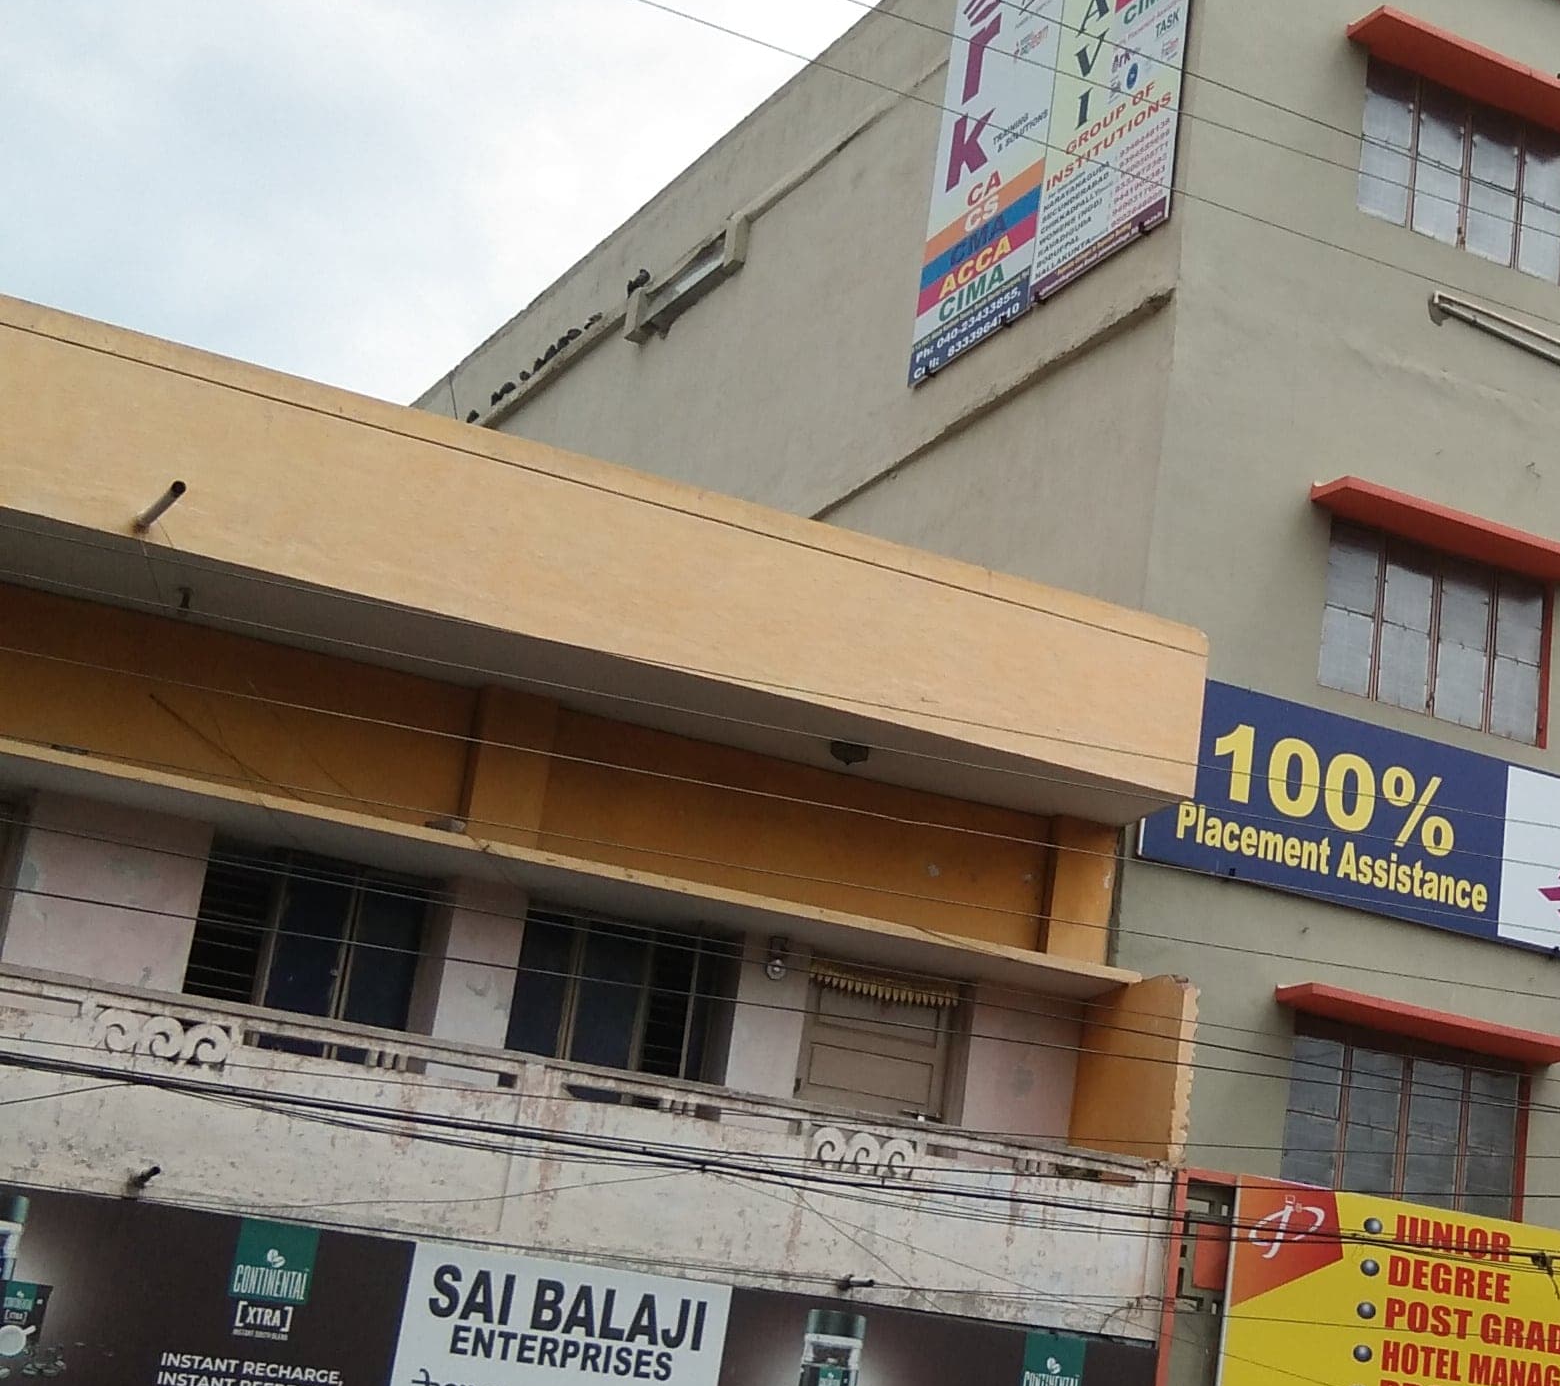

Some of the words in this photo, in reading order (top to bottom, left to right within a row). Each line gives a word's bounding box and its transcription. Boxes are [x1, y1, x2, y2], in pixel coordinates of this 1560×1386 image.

[1155, 8, 1180, 37] TASK
[1046, 92, 1172, 192] INSTITUTIONS
[1066, 103, 1126, 155] GROUP
[1132, 81, 1156, 107] OF
[967, 170, 1002, 206] CA
[964, 197, 999, 232] CS
[950, 218, 1008, 264] CMA
[939, 235, 1012, 299] ACCA
[938, 263, 1004, 322] CIMA
[916, 345, 934, 363] Ph:
[1214, 723, 1455, 857] 100%
[1176, 801, 1331, 875] Placement
[1336, 842, 1489, 913] Assistance
[1393, 1214, 1511, 1262] JUNIOR
[233, 1264, 309, 1300] CONTINENTAL
[1387, 1255, 1511, 1305] DEGREE
[429, 1264, 516, 1326] SAI
[531, 1279, 707, 1351] BALAJI
[1384, 1298, 1472, 1341] POST
[161, 1352, 239, 1375] INSTANT
[450, 1325, 672, 1381] ENTERPRISES
[1380, 1340, 1460, 1381] HOTEL
